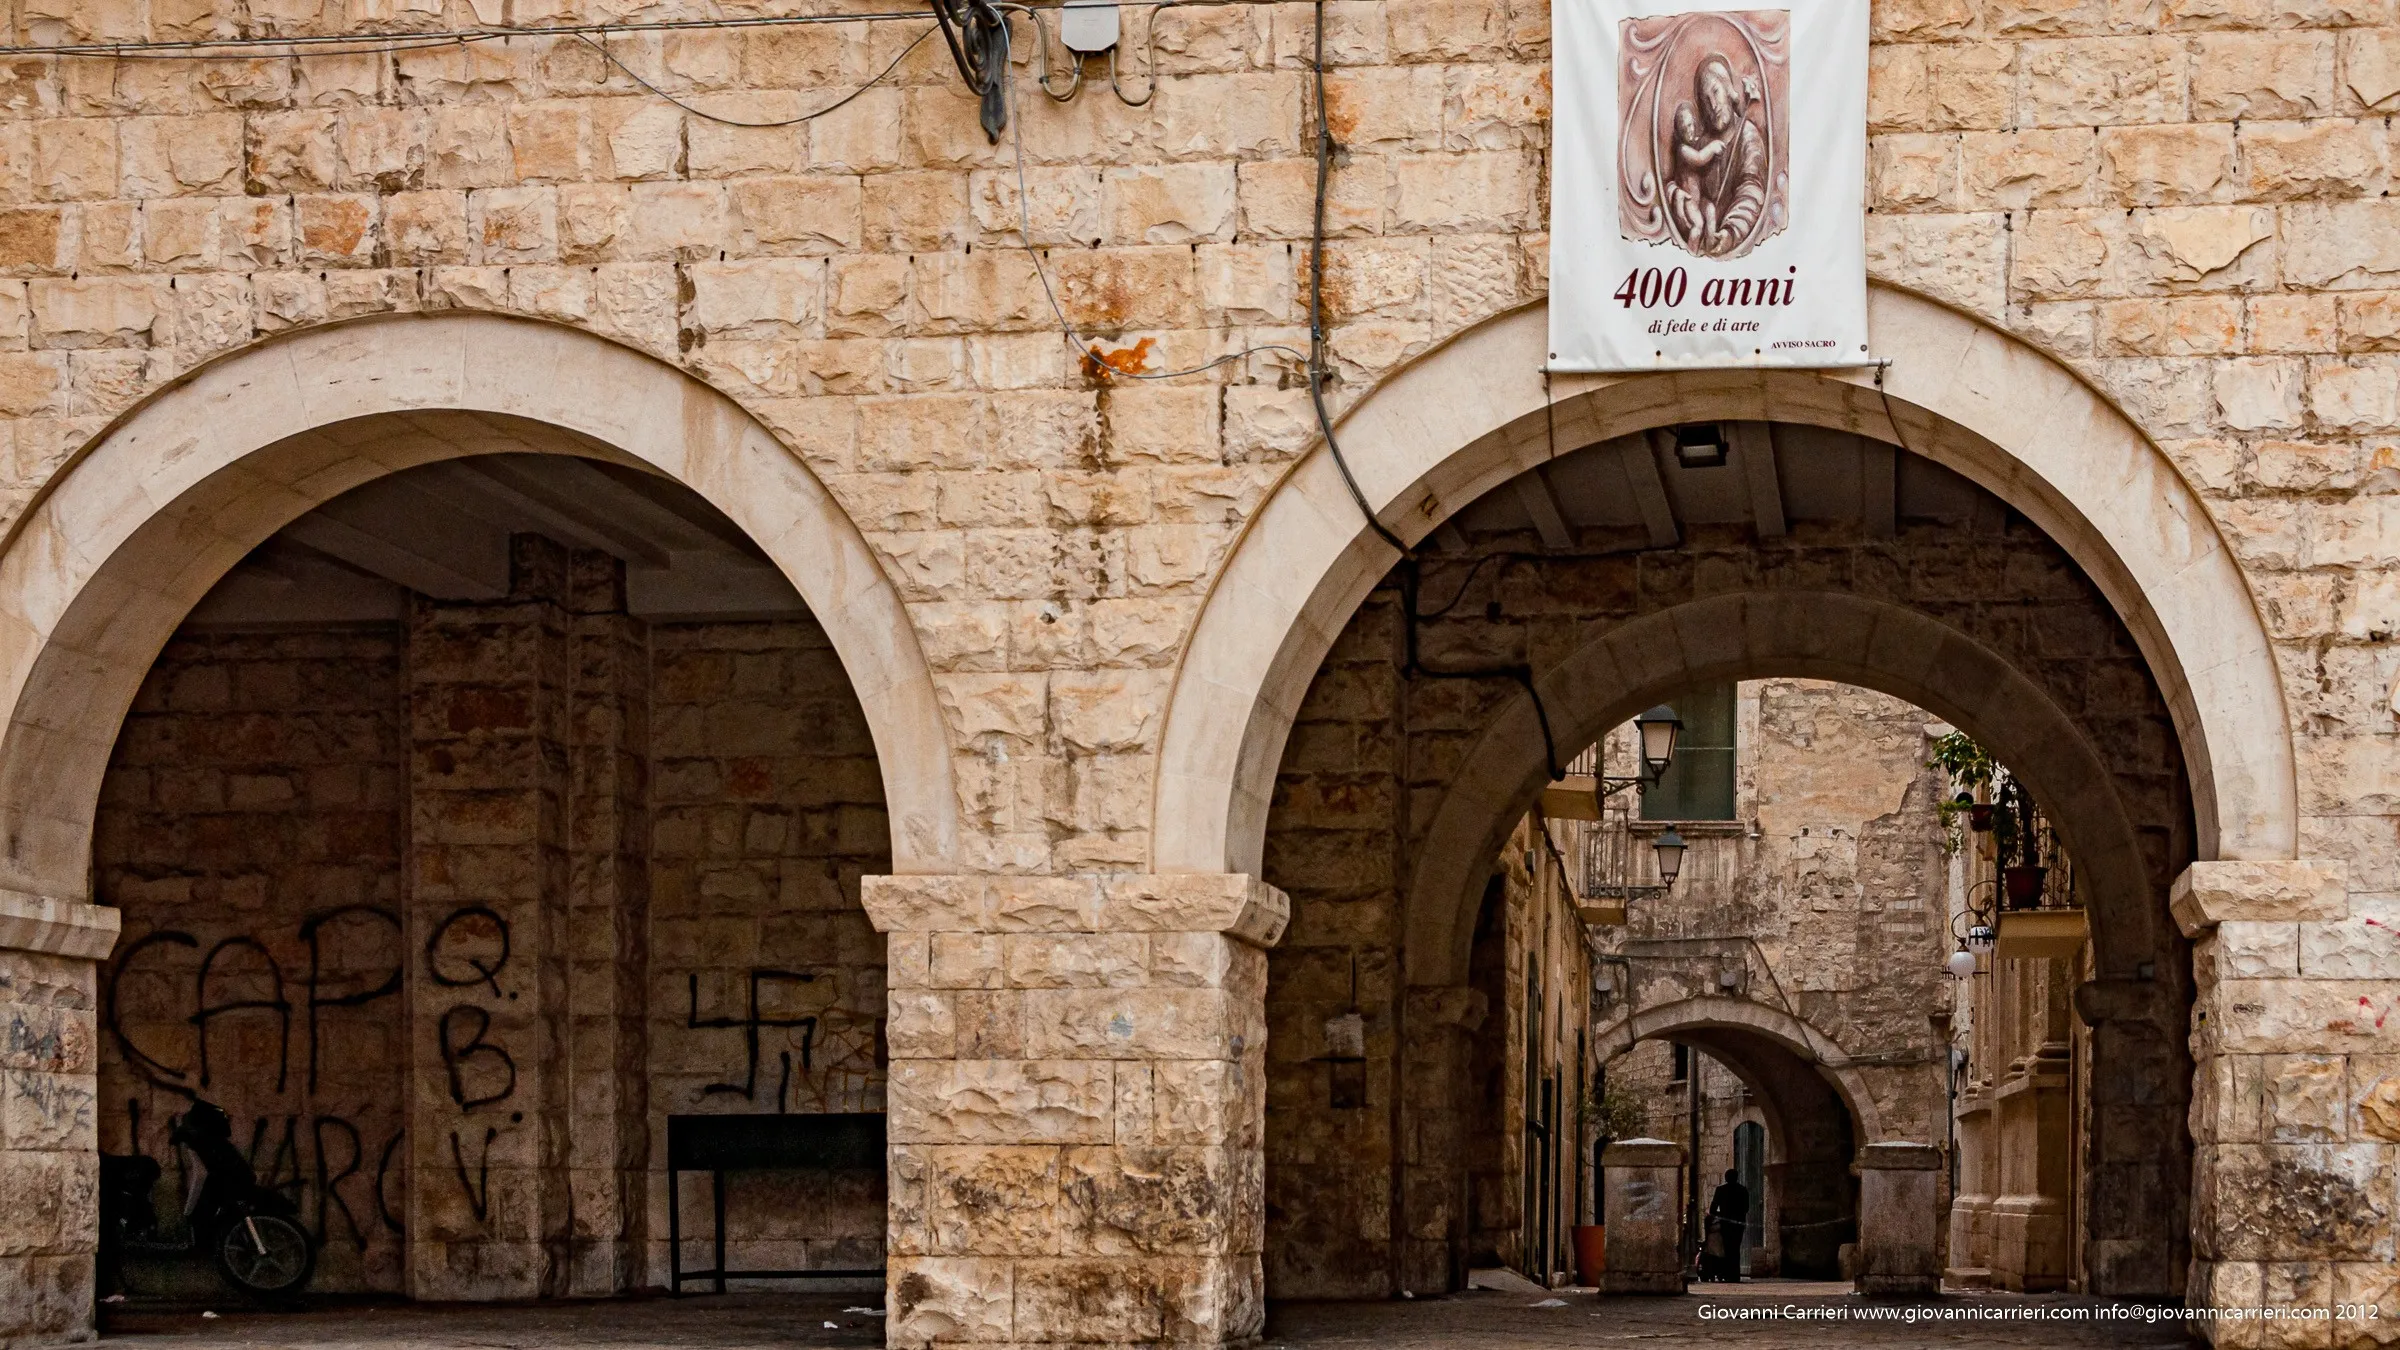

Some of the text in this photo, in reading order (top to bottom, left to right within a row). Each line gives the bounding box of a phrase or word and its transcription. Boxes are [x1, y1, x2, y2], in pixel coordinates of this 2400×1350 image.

[1613, 265, 1797, 309] 400 anni
[1648, 318, 1760, 337] di fede e di arte
[1771, 340, 1836, 349] AVVISO SACRO
